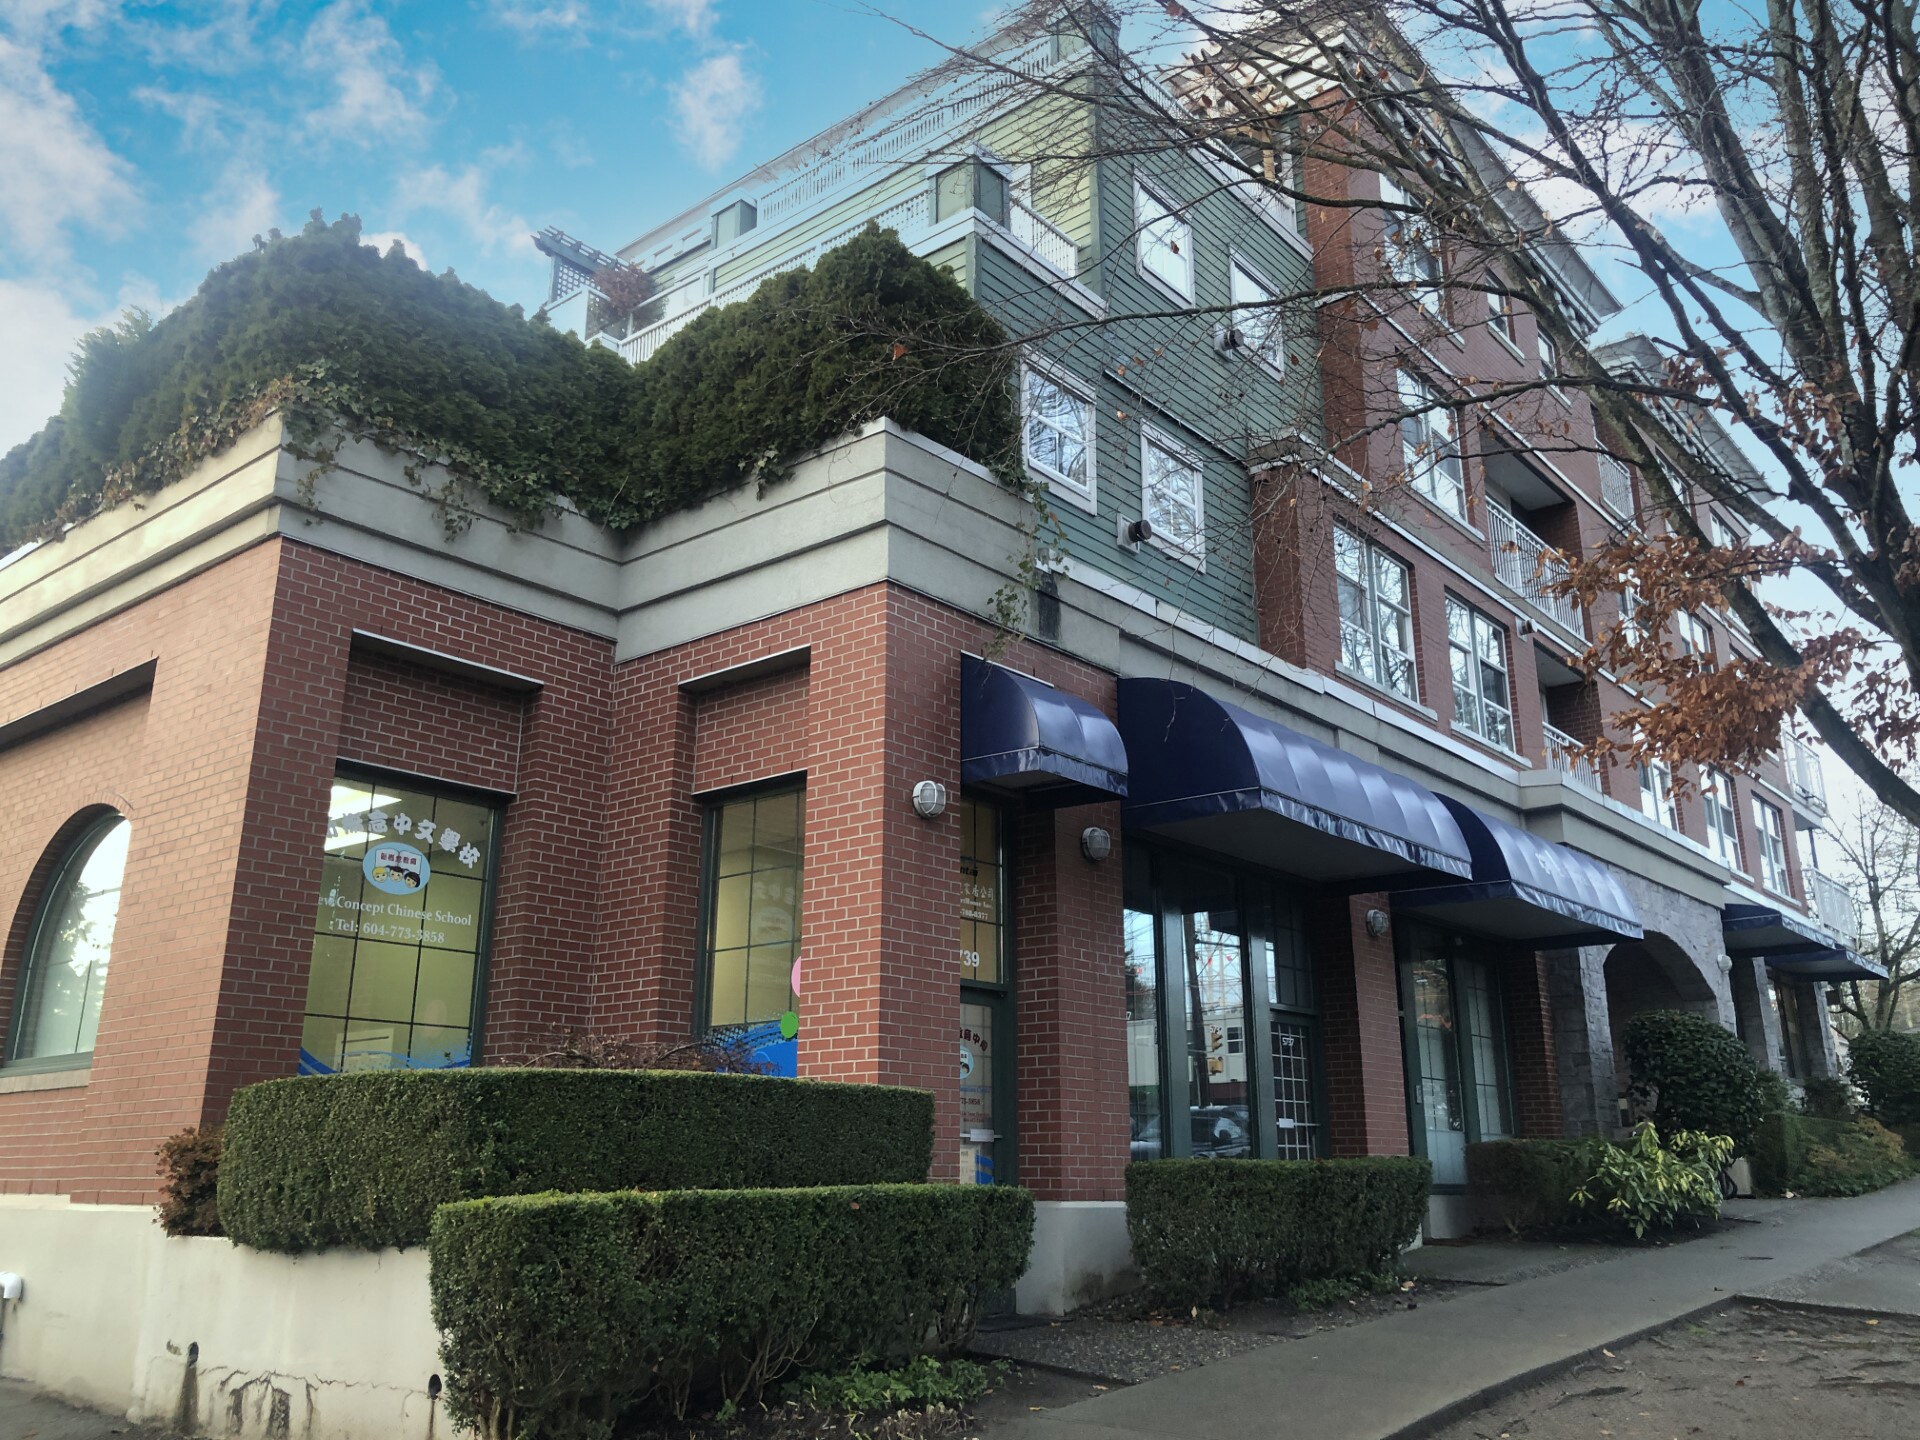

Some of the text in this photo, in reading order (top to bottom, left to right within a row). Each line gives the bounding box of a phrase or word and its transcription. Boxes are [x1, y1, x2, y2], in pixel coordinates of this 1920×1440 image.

[336, 896, 384, 915] Concept
[387, 903, 432, 920] Chinese
[435, 910, 472, 926] School
[336, 918, 445, 943] Tel: 604-773-3858
